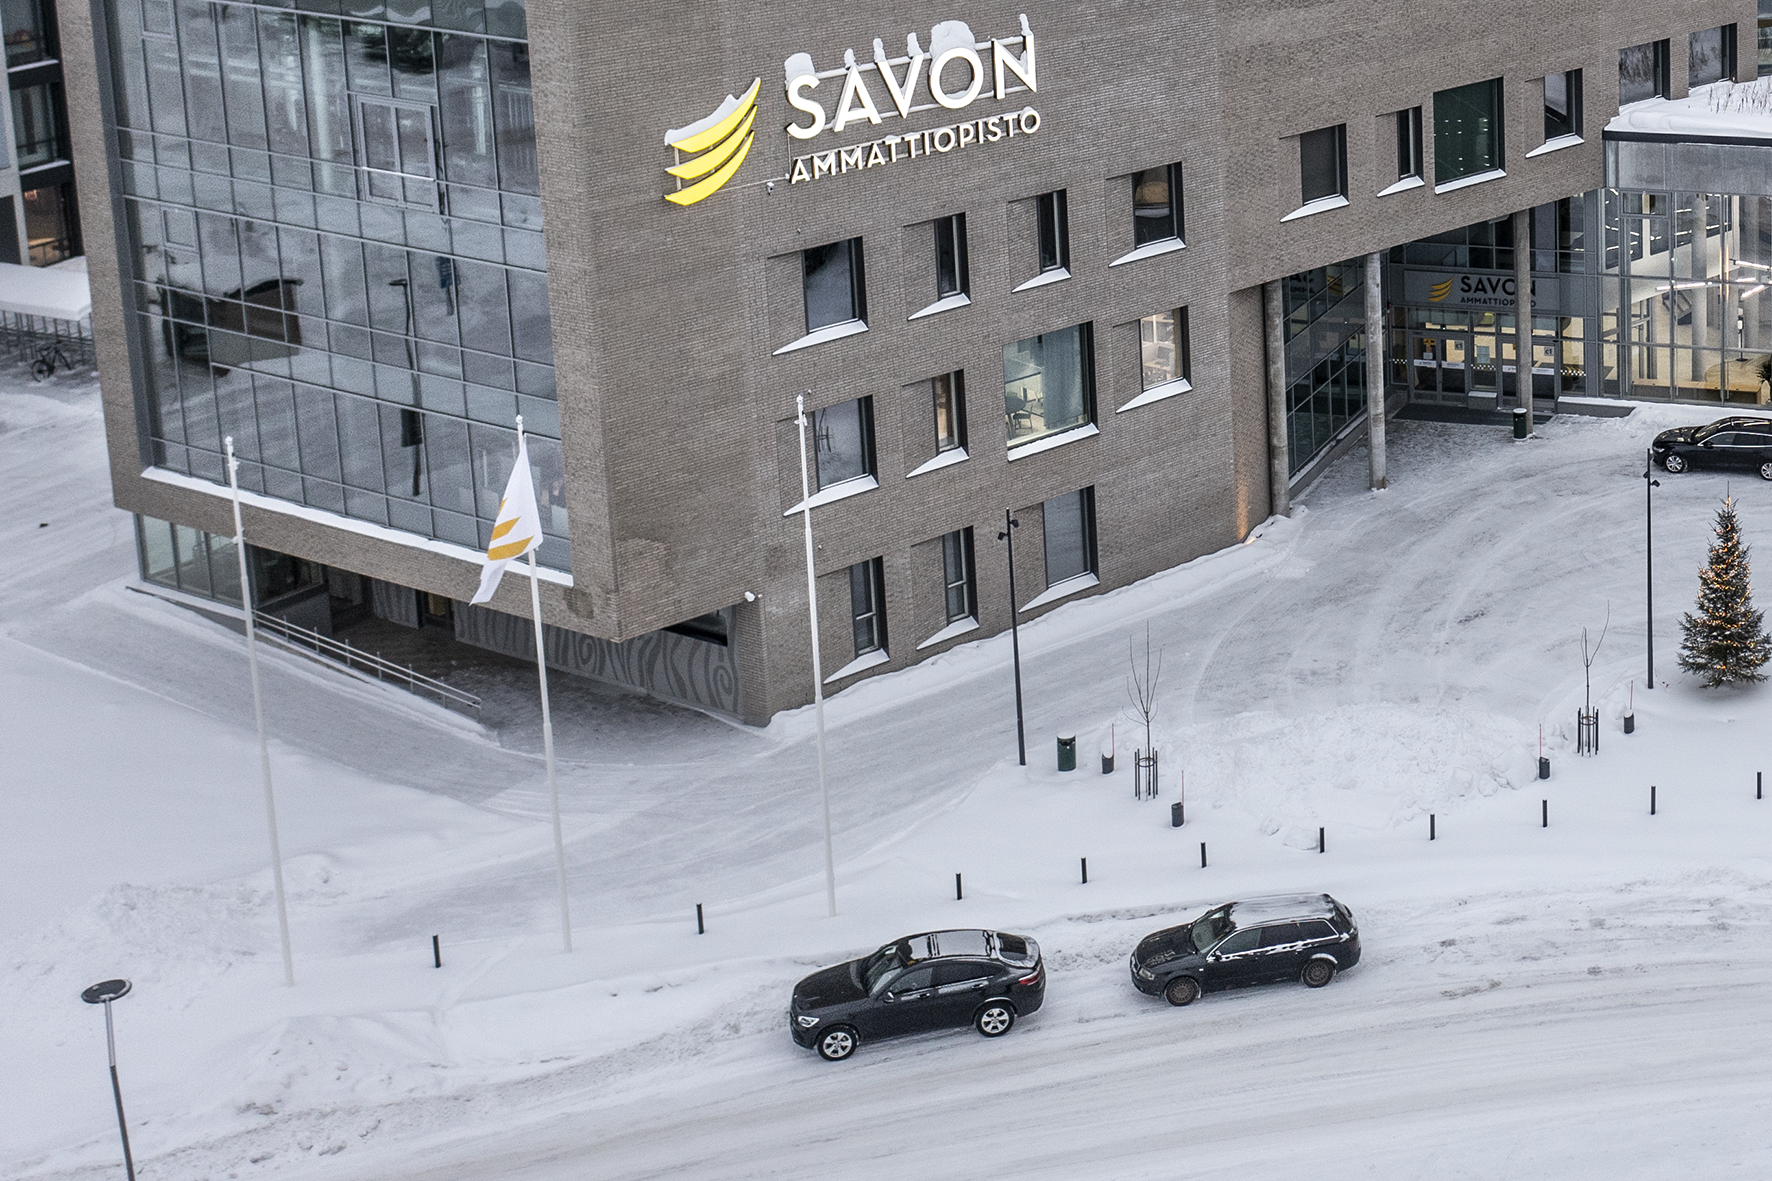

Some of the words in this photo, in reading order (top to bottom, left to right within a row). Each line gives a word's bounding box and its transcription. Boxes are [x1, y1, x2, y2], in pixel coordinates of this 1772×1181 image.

[786, 35, 1037, 139] SAVON
[790, 109, 1041, 184] AMMATTIOPISTO
[1460, 297, 1536, 307] AMMATTIOPO
